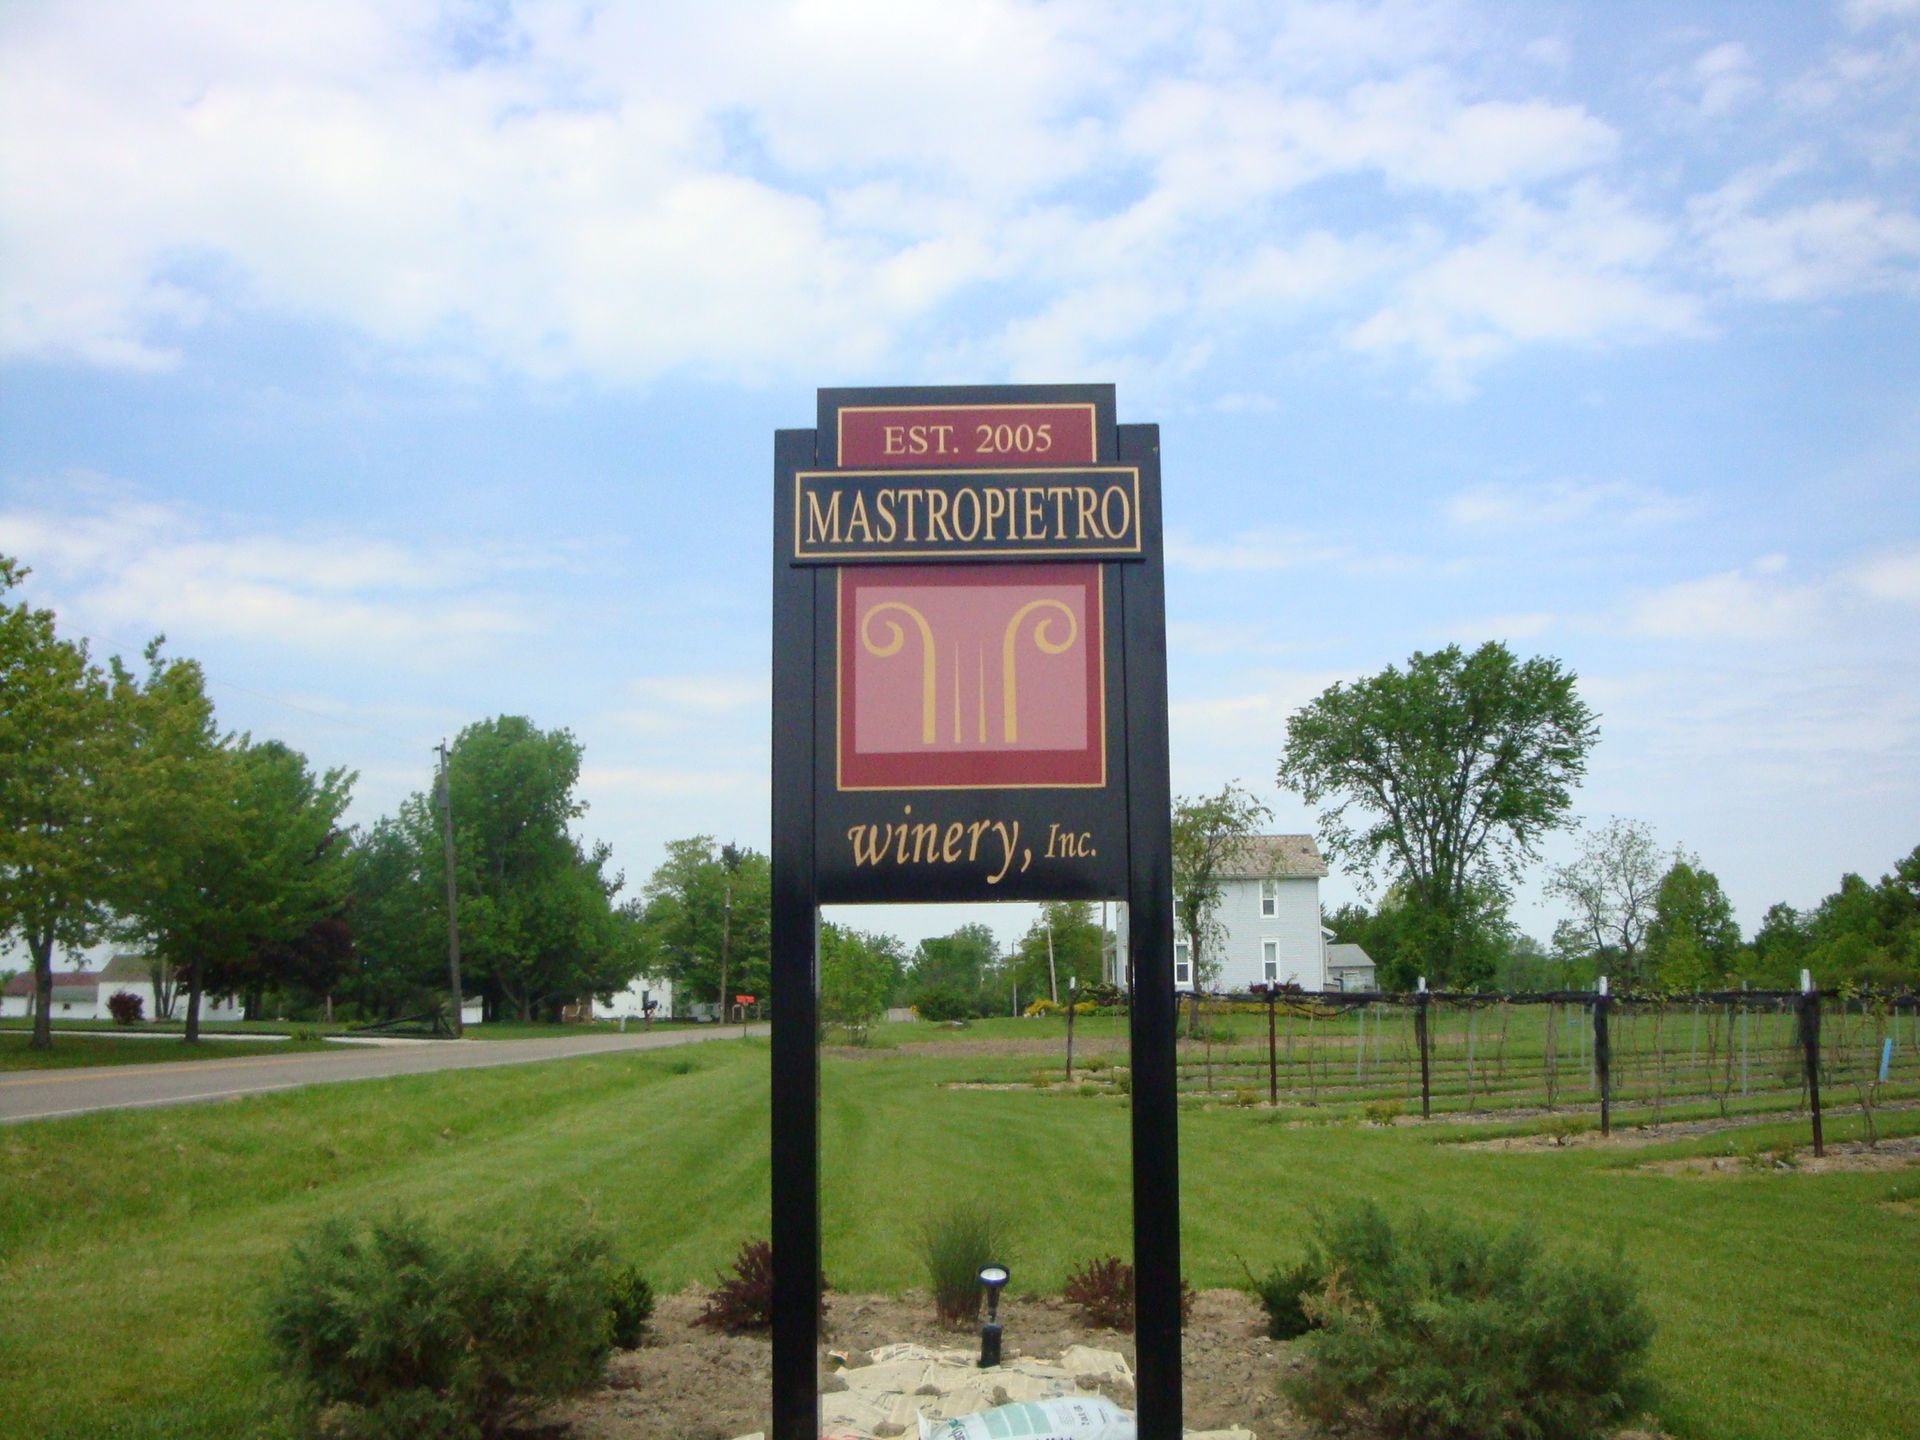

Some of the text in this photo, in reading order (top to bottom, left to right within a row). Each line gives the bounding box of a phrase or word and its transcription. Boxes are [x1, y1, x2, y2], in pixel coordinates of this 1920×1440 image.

[883, 424, 1052, 454] EST. 2005
[805, 485, 1131, 543] MASTROPIETRO
[847, 804, 1097, 884] winery, Inc.
